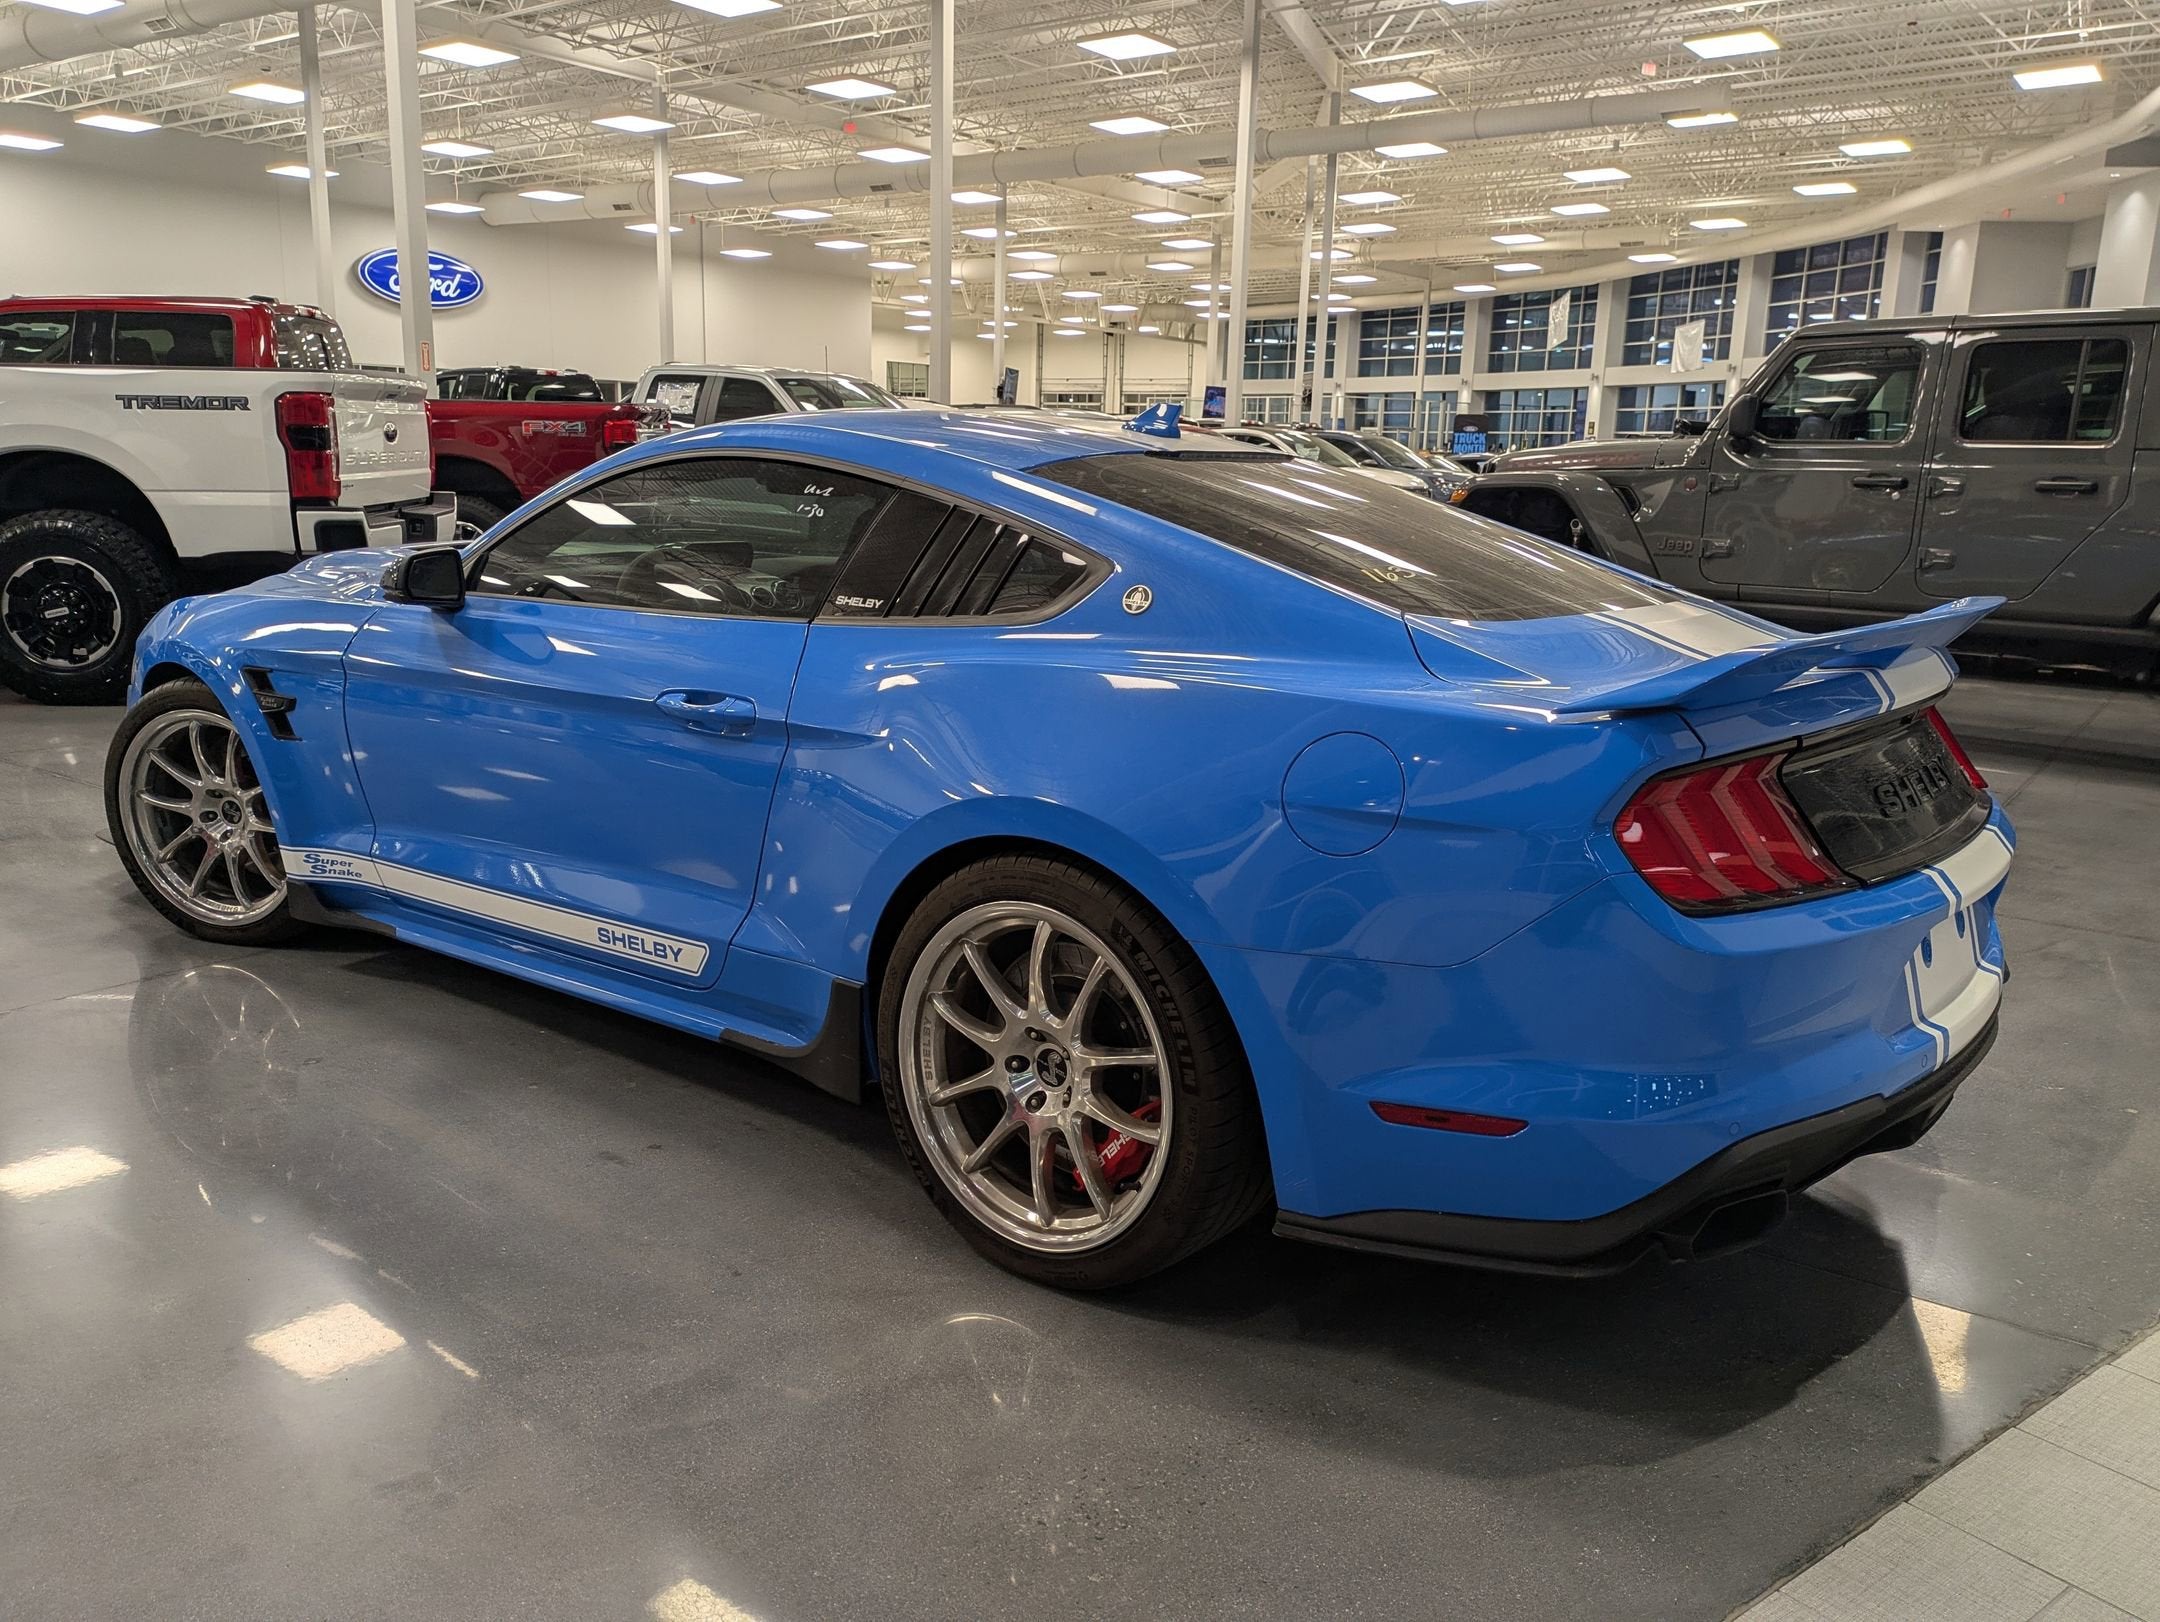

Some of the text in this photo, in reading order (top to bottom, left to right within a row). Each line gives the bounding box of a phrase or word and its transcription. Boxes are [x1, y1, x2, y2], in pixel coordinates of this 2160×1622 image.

[115, 394, 251, 411] TREMOR
[522, 420, 586, 436] FX4
[1454, 433, 1487, 444] TRUCK
[1453, 444, 1486, 454] MONTH
[796, 503, 825, 518] 1-30
[1656, 536, 1694, 554] Jeep
[836, 595, 884, 609] SHELBY
[303, 853, 354, 868] Super
[309, 864, 363, 878] Snake
[597, 927, 683, 962] SHELBY
[1134, 951, 1197, 1089] MICHELIN
[922, 1015, 934, 1081] SHELBY
